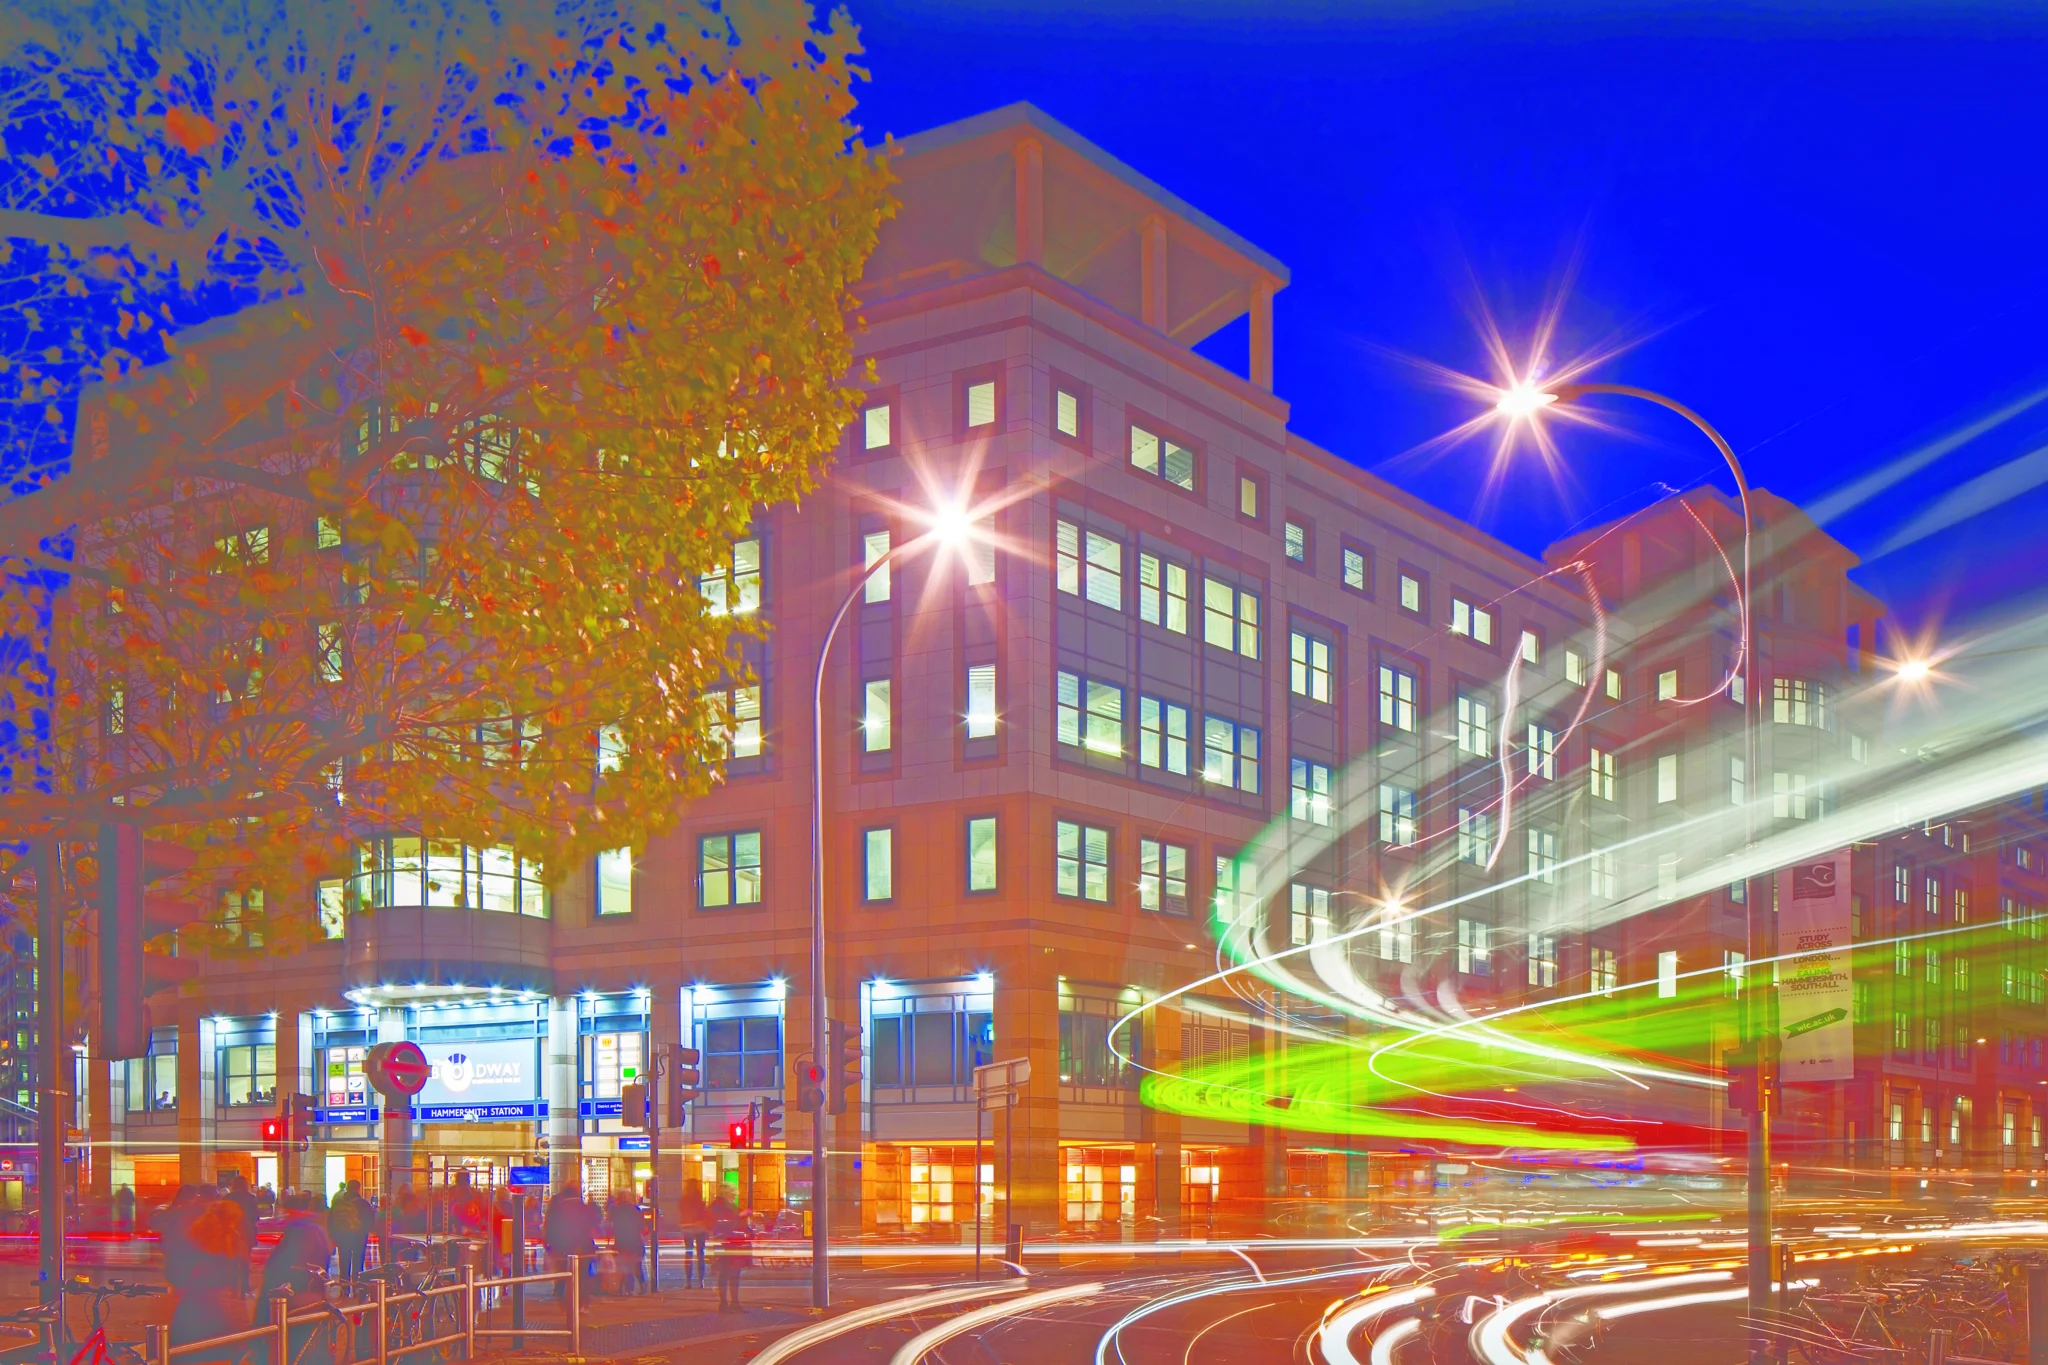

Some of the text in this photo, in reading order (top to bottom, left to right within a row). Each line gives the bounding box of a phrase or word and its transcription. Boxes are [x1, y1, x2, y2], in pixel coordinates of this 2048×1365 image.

[1799, 933, 1829, 944] STUDY
[1796, 940, 1833, 950] ACROSS
[1782, 973, 1848, 985] HAMMERSMITH,
[1790, 981, 1839, 991] SOUTHALL
[1796, 1013, 1836, 1032] wlc.ac.uk
[431, 1106, 524, 1118] HAMMERSMITH STATION
